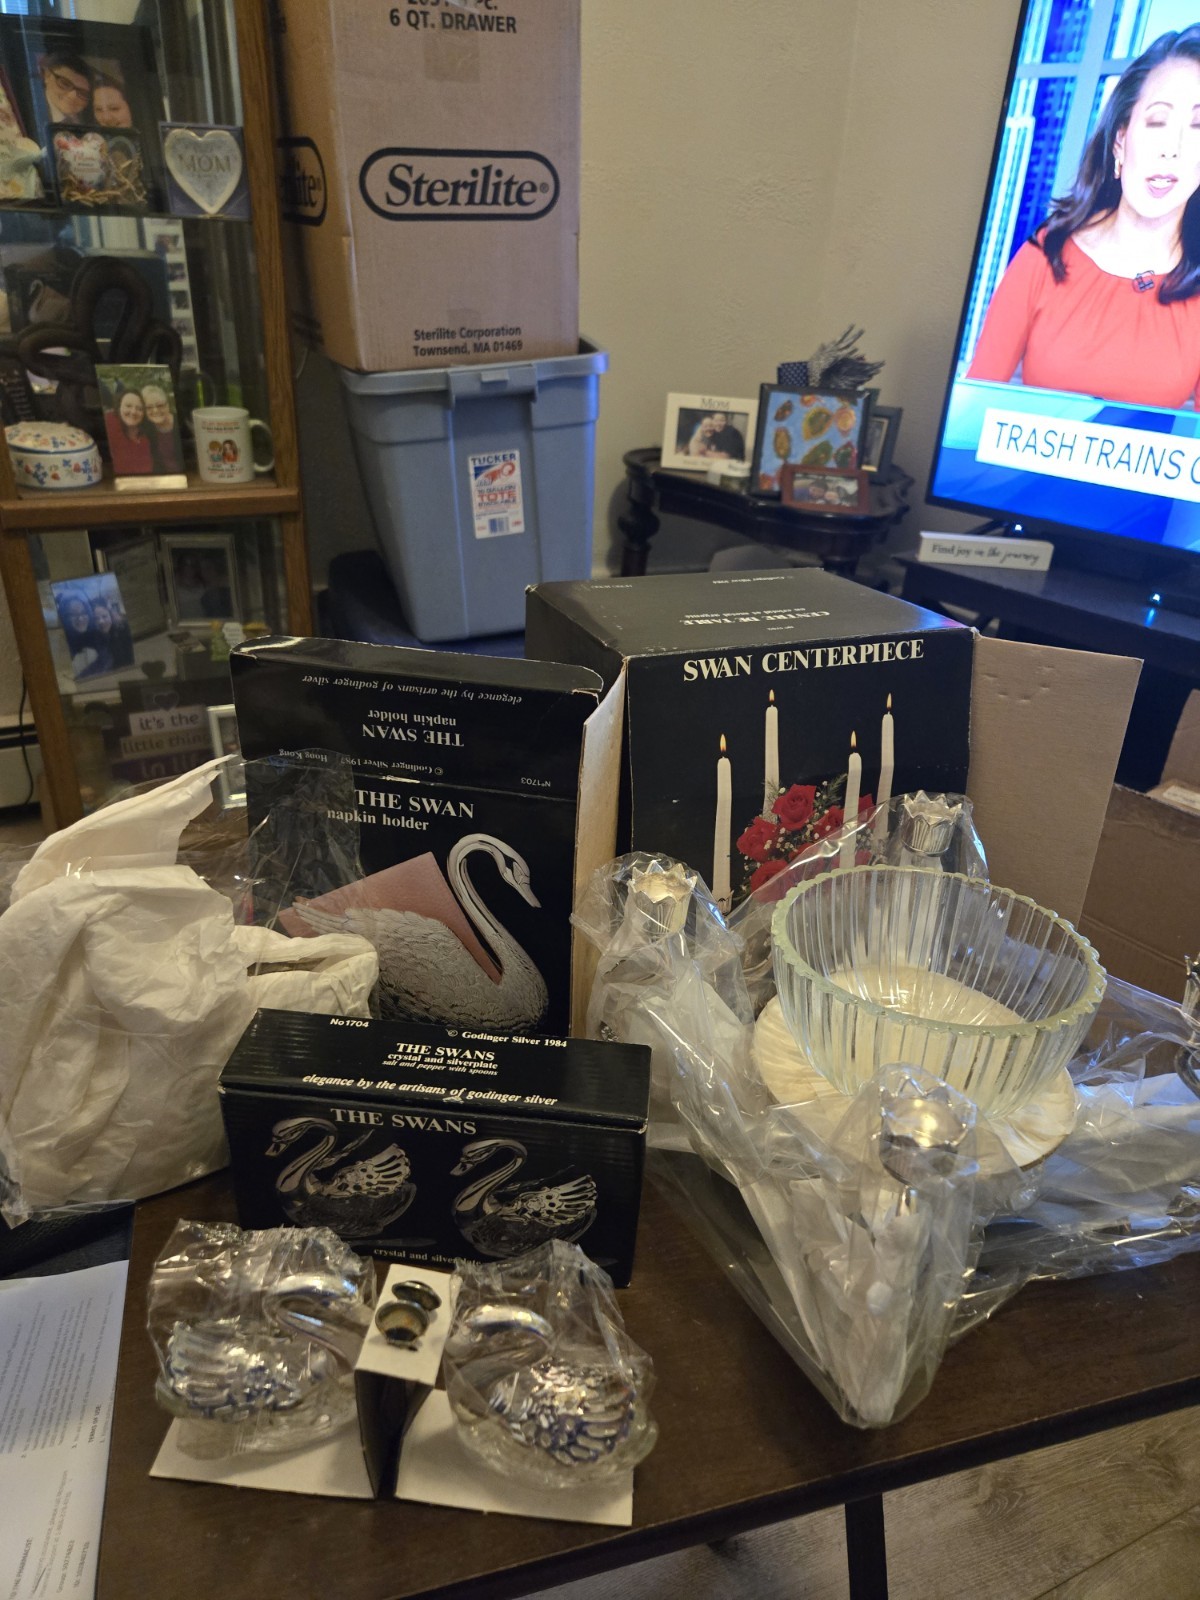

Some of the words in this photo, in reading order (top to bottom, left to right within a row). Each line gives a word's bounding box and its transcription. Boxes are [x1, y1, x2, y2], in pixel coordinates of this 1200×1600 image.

[389, 8, 400, 27] 6
[406, 9, 435, 30] QT.
[441, 12, 517, 34] DRAWER
[413, 327, 457, 342] Sterilite
[459, 325, 522, 341] Corporation
[412, 343, 471, 357] Townsend,
[473, 342, 491, 354] MA
[493, 340, 523, 353] 01469
[471, 452, 517, 466] TUCKER
[996, 421, 1078, 462] TRASH
[1084, 436, 1186, 481] TRAINS
[478, 490, 517, 502] TOTE
[932, 544, 955, 555] Find
[955, 547, 971, 558] joy
[683, 655, 752, 682] SWAN
[762, 639, 924, 673] CENTERPIECE
[301, 674, 330, 684] silver
[332, 677, 378, 690] godinger
[381, 680, 394, 692] of
[397, 683, 438, 694] artisans
[442, 687, 457, 698] the
[462, 689, 475, 700] by
[478, 692, 522, 704] elegance
[140, 716, 165, 731] it's
[170, 713, 199, 728] the
[367, 709, 408, 724] holder
[413, 714, 457, 727] napkin
[362, 723, 418, 742] SWAN
[424, 729, 464, 747] THE
[122, 738, 164, 755] little
[278, 748, 304, 761] Kong
[304, 752, 328, 764] Hong
[363, 758, 389, 769] Silver
[391, 762, 432, 774] Godinger
[354, 788, 401, 811] THE
[408, 796, 475, 819] SWAN
[327, 809, 377, 825] napkin
[382, 814, 430, 831] holder
[462, 1031, 509, 1043] Godinger
[512, 1034, 541, 1045] Silver
[544, 1038, 568, 1048] 1984
[396, 1042, 432, 1056] THE
[435, 1046, 496, 1062] SWANS
[382, 1058, 399, 1067] salt
[399, 1061, 416, 1069] and
[418, 1063, 446, 1072] pepper
[448, 1065, 468, 1073] with
[468, 1068, 498, 1076] spoons
[387, 1052, 422, 1064] crystal
[424, 1056, 443, 1065] and
[446, 1057, 499, 1070] silverplate
[302, 1074, 354, 1087] elegance
[356, 1077, 375, 1090] by
[376, 1079, 397, 1091] the
[398, 1082, 447, 1096] artisans
[449, 1086, 467, 1099] of
[466, 1088, 522, 1104] godinger
[525, 1093, 559, 1107] silver
[330, 1107, 384, 1127] THE
[392, 1113, 477, 1136] SWANS
[374, 1248, 406, 1259] crystal
[409, 1252, 429, 1262] and
[431, 1254, 482, 1267] silverlate
